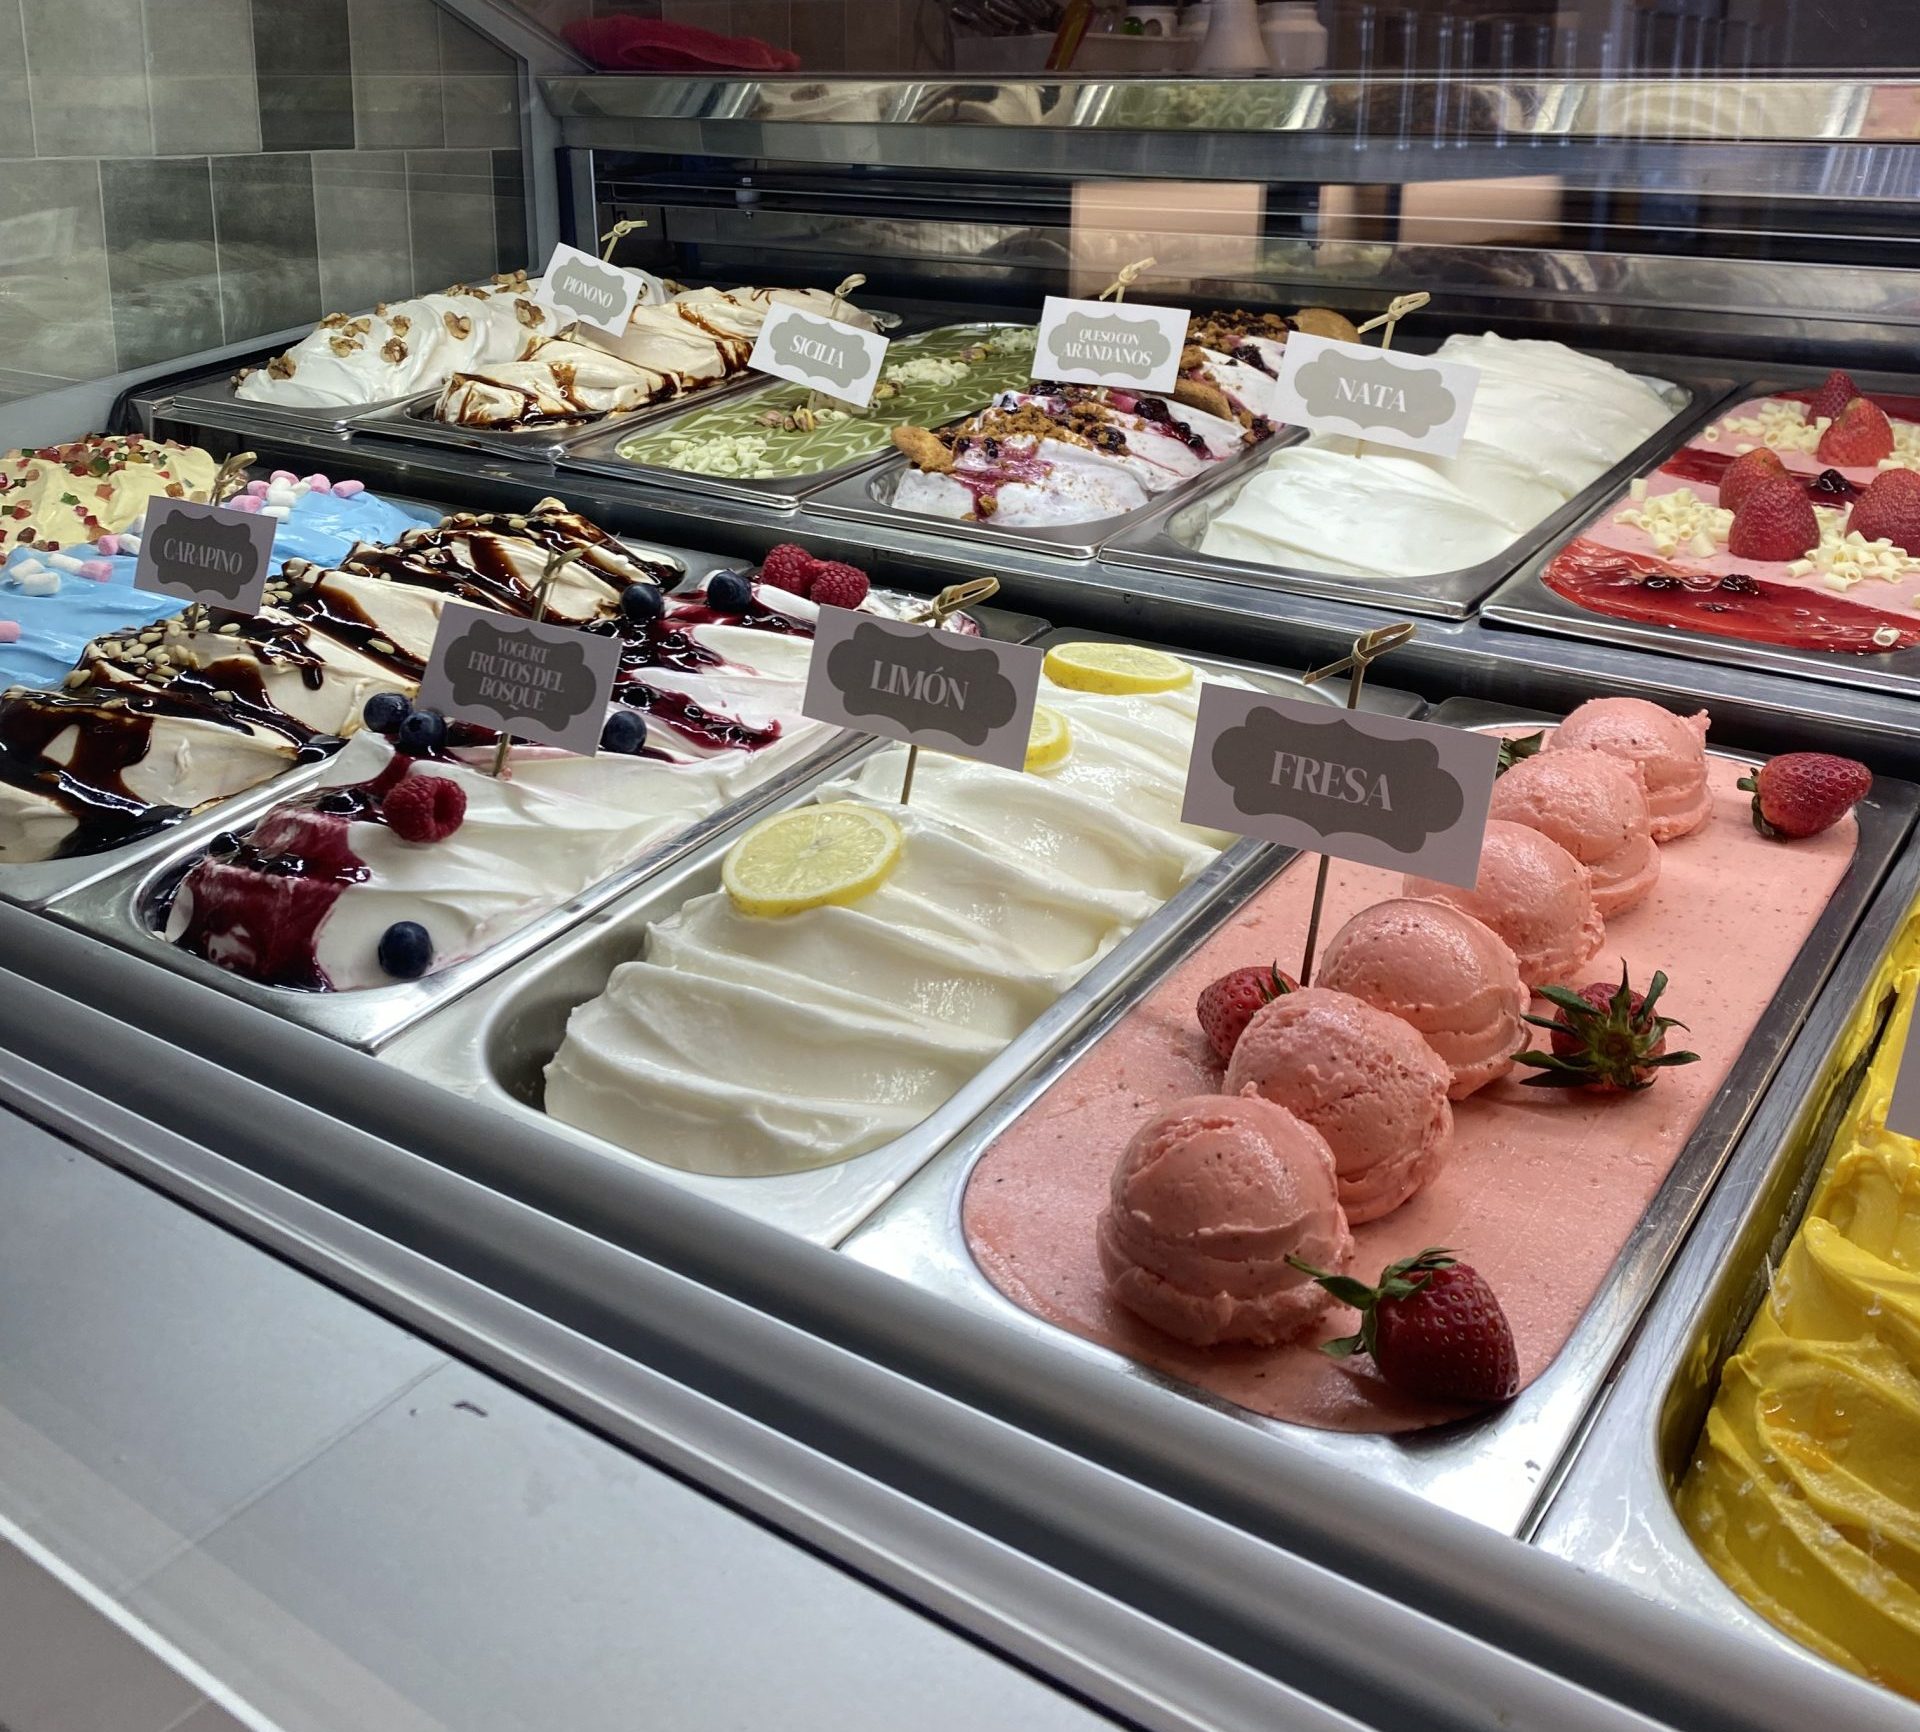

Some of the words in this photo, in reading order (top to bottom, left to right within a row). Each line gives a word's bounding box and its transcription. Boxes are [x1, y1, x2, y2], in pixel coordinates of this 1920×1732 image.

[563, 276, 613, 309] PIONONO
[790, 335, 844, 369] SICILIA
[1079, 330, 1116, 344] QUESO
[1118, 333, 1140, 345] CON
[1335, 377, 1407, 413] NATA
[162, 538, 243, 576] CARAPINO
[498, 637, 550, 664] YOGURT
[467, 651, 532, 684] FRUTOS
[531, 668, 565, 693] DEL
[870, 660, 969, 711] LIMÓN
[478, 678, 545, 711] BOSQUE
[1270, 750, 1394, 812] FRESA
